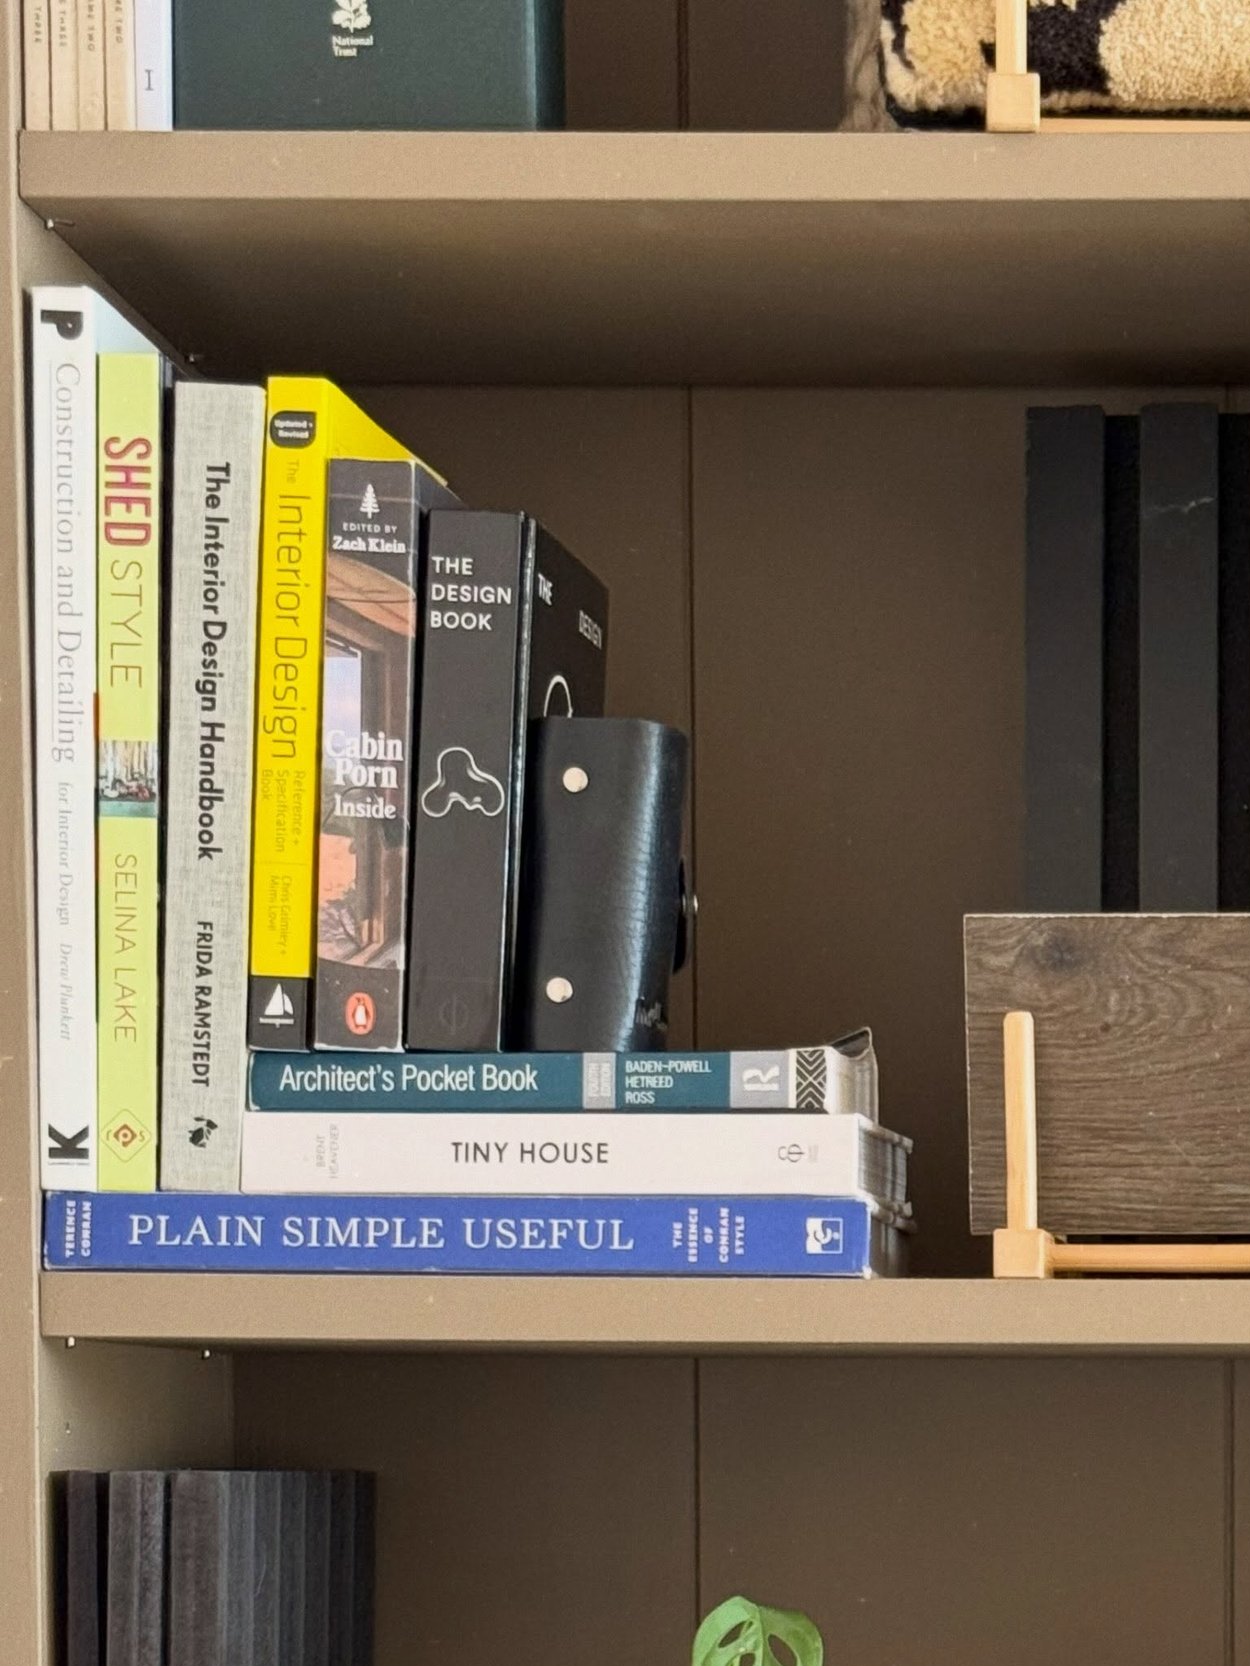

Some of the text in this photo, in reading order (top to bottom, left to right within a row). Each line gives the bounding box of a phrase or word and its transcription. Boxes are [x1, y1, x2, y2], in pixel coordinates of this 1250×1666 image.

[332, 35, 374, 46] National
[332, 535, 406, 553] Zach Klein
[342, 522, 398, 535] EDITED BY
[103, 435, 152, 688] SHED STYLE
[431, 555, 474, 576] THE
[430, 583, 512, 605] DESIGN
[537, 572, 553, 606] THE
[263, 460, 312, 760] The Interior Design
[429, 610, 493, 631] BOOK
[51, 362, 85, 926] Construction and Detailing for Interior Design
[195, 462, 231, 860] The Interior Design Handbook
[324, 728, 404, 762] Cabin
[261, 769, 274, 801] Book
[333, 757, 399, 789] Porn
[274, 769, 291, 853] Specification
[292, 769, 306, 835] Reference
[334, 793, 396, 820] Inside
[114, 853, 138, 1043] SELINA LAKE
[60, 942, 74, 1041] Drew Plunkett
[191, 920, 214, 1088] FRIDA RAMSTEDT
[279, 1063, 539, 1092] Architect's Pocket Book
[624, 1060, 712, 1074] BADEN-POWELL
[624, 1075, 674, 1089] HETREED
[624, 1091, 656, 1104] ROSS
[451, 1141, 609, 1164] TINY HOUSE
[65, 1200, 76, 1258] TERENCE
[81, 1200, 92, 1258] CONRAN
[128, 1213, 635, 1250] PLAIN SIMPLE USEFUL
[672, 1222, 683, 1249] THE
[688, 1207, 698, 1263] ESSENCE
[704, 1226, 714, 1244] OF
[719, 1207, 729, 1263] CONRAN
[734, 1215, 745, 1255] STYLE
